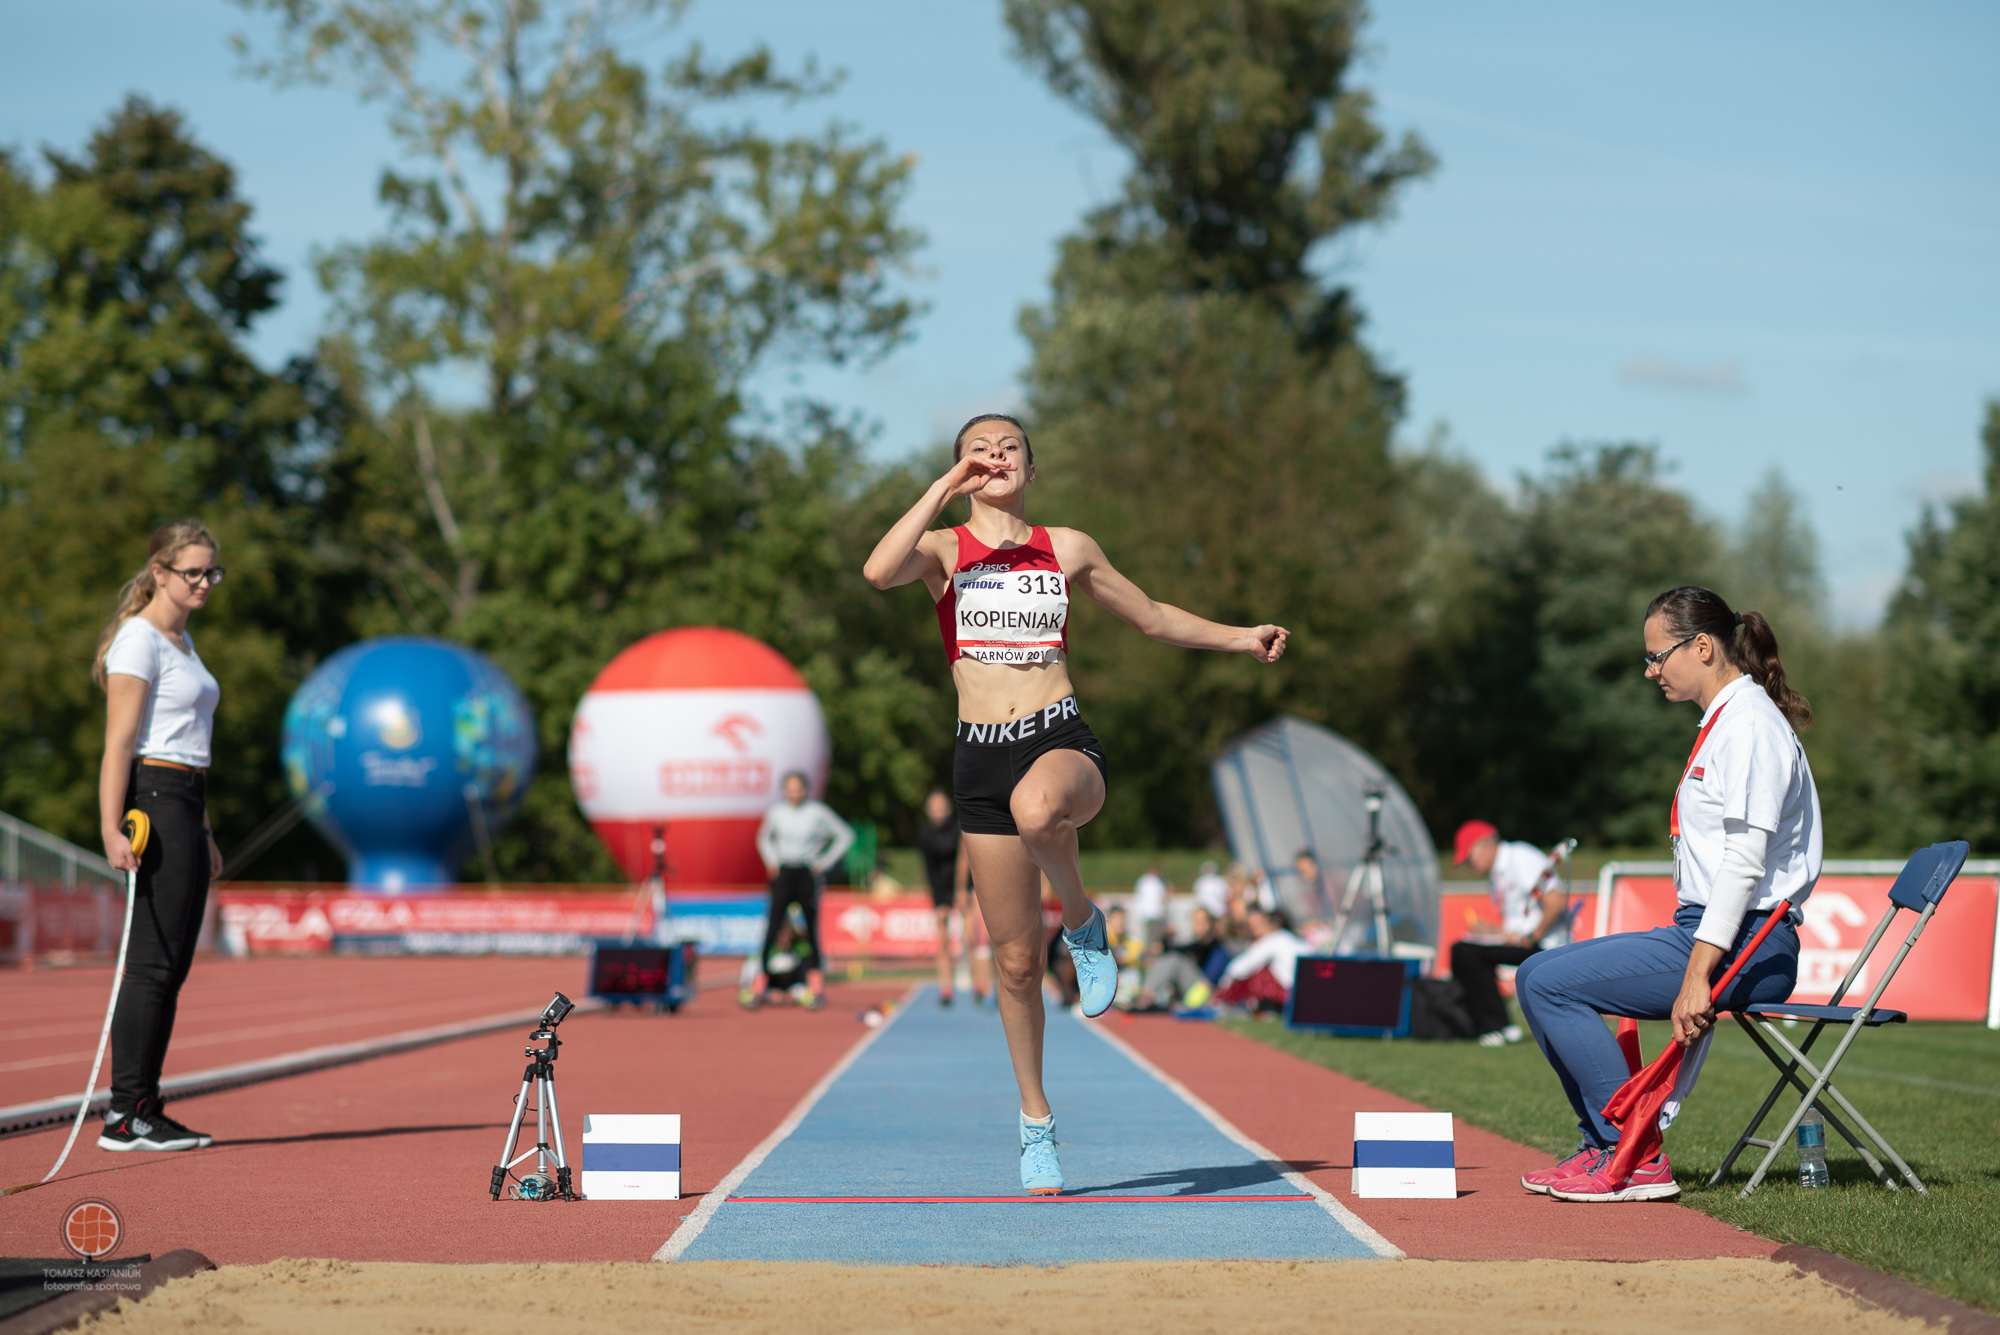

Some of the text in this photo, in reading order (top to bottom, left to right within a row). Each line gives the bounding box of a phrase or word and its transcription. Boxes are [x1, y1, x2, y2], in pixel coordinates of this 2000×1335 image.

[1017, 574, 1062, 596] 313
[960, 610, 1063, 629] KOPIENIAK
[975, 648, 1025, 661] TARNÓW
[966, 712, 1037, 743] NIKE
